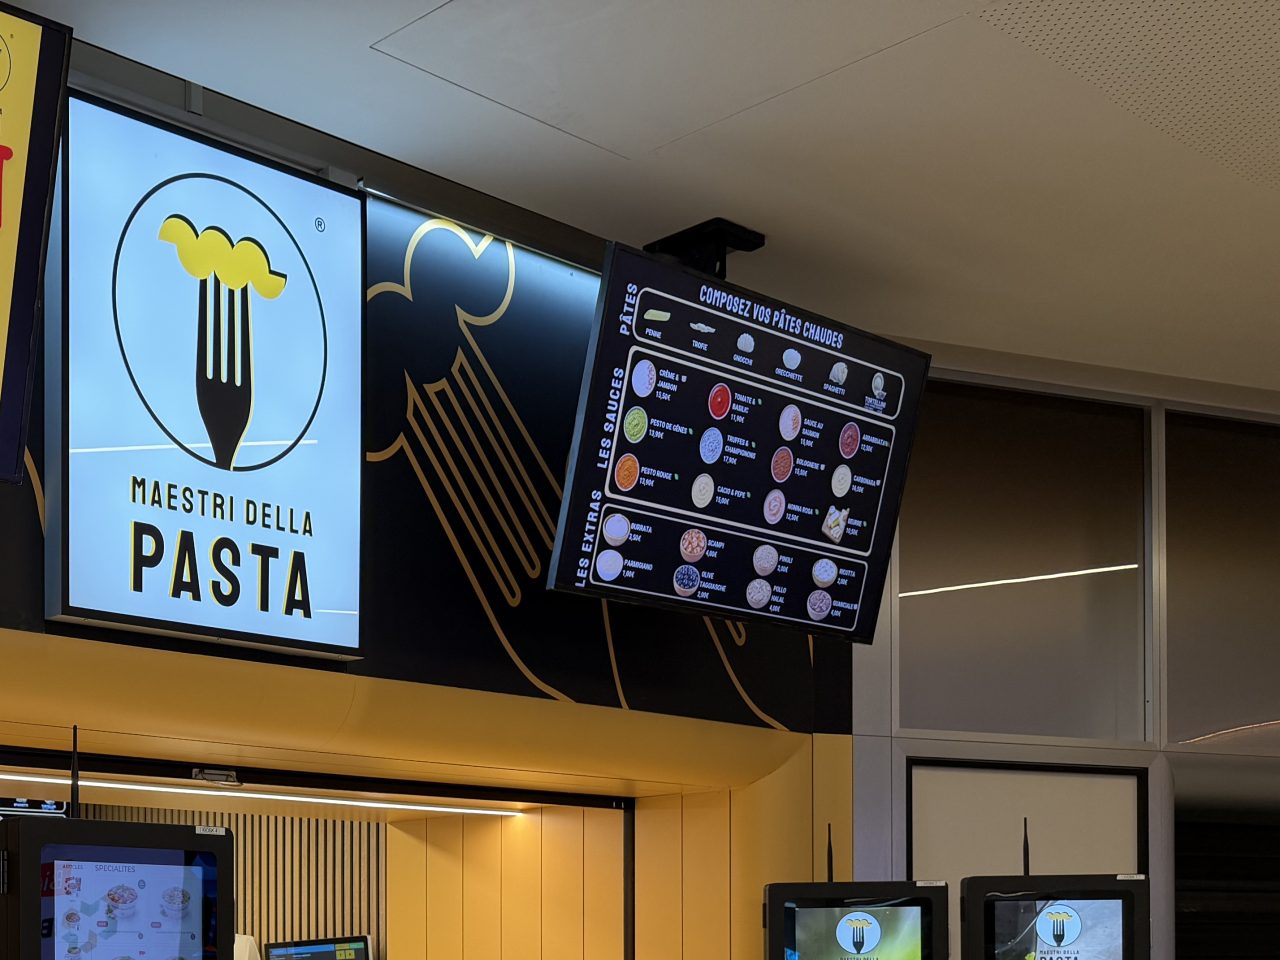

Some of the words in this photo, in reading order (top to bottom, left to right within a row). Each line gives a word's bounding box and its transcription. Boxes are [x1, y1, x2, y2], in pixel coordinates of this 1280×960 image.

[619, 283, 638, 336] PÂTES
[699, 284, 750, 318] COMPOSEZ
[753, 303, 771, 324] VOS
[772, 308, 802, 335] PÂTES
[802, 321, 844, 350] CHAUDES
[603, 367, 624, 433] SAUCES
[597, 437, 612, 470] LES
[129, 475, 235, 523] MAESTRI
[246, 498, 315, 538] DELLA
[582, 489, 602, 552] EXTRAS
[129, 519, 313, 620] PASTA
[575, 558, 590, 588] LES
